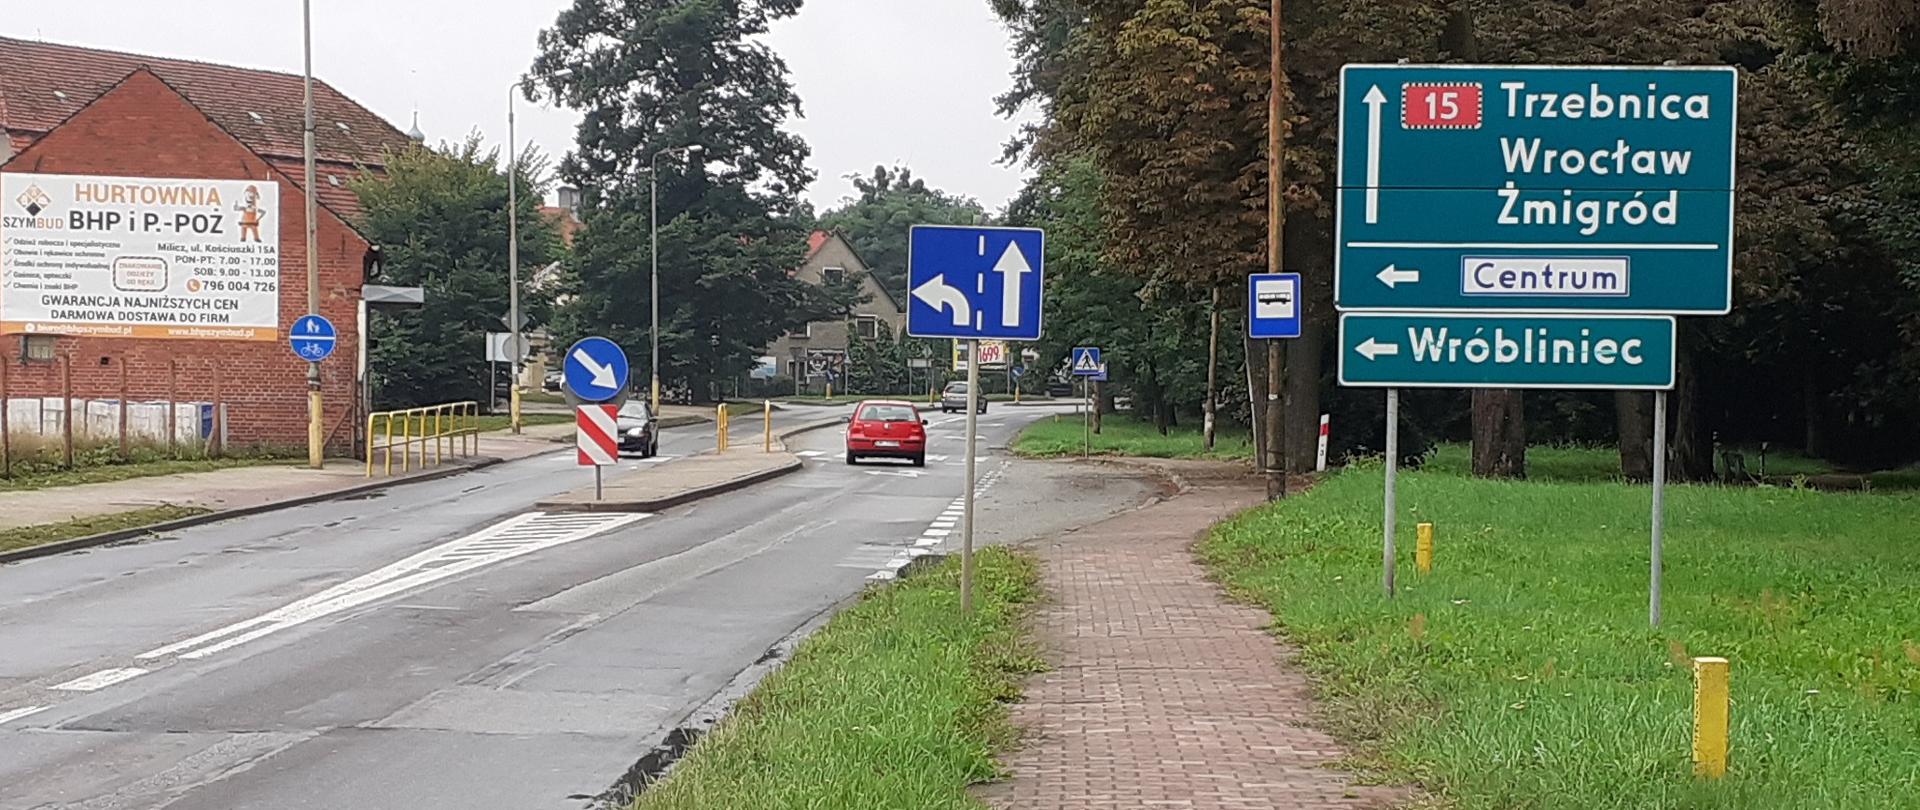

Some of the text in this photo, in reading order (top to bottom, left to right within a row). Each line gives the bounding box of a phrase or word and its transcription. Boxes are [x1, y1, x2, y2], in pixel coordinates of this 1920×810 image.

[1424, 92, 1459, 121] 15
[1501, 82, 1709, 119] Trzebnica
[1500, 138, 1692, 175] Wrocław
[75, 183, 222, 206] HURTOWNIA
[1497, 181, 1677, 235] Żmigród
[3, 216, 64, 229] SZYMBUD
[69, 208, 223, 234] BHP i P.-POŻ
[158, 243, 275, 254] Milicz, ul. Kościuszki 15A
[175, 255, 216, 265] PON-PT:
[219, 256, 240, 265] 7.00
[250, 257, 276, 266] 17.00
[194, 267, 217, 276] SOB:
[219, 268, 240, 277] 9.00
[250, 269, 276, 278] 13.00
[1473, 263, 1617, 290] Centrum
[202, 280, 276, 292] 796 004 726
[41, 294, 239, 310] GWARANCJA NAJNIŻSZYCH CEN
[51, 310, 230, 324] DARMOWA DOSTAWA DO FIRM
[1408, 327, 1643, 365] Wróbliniec
